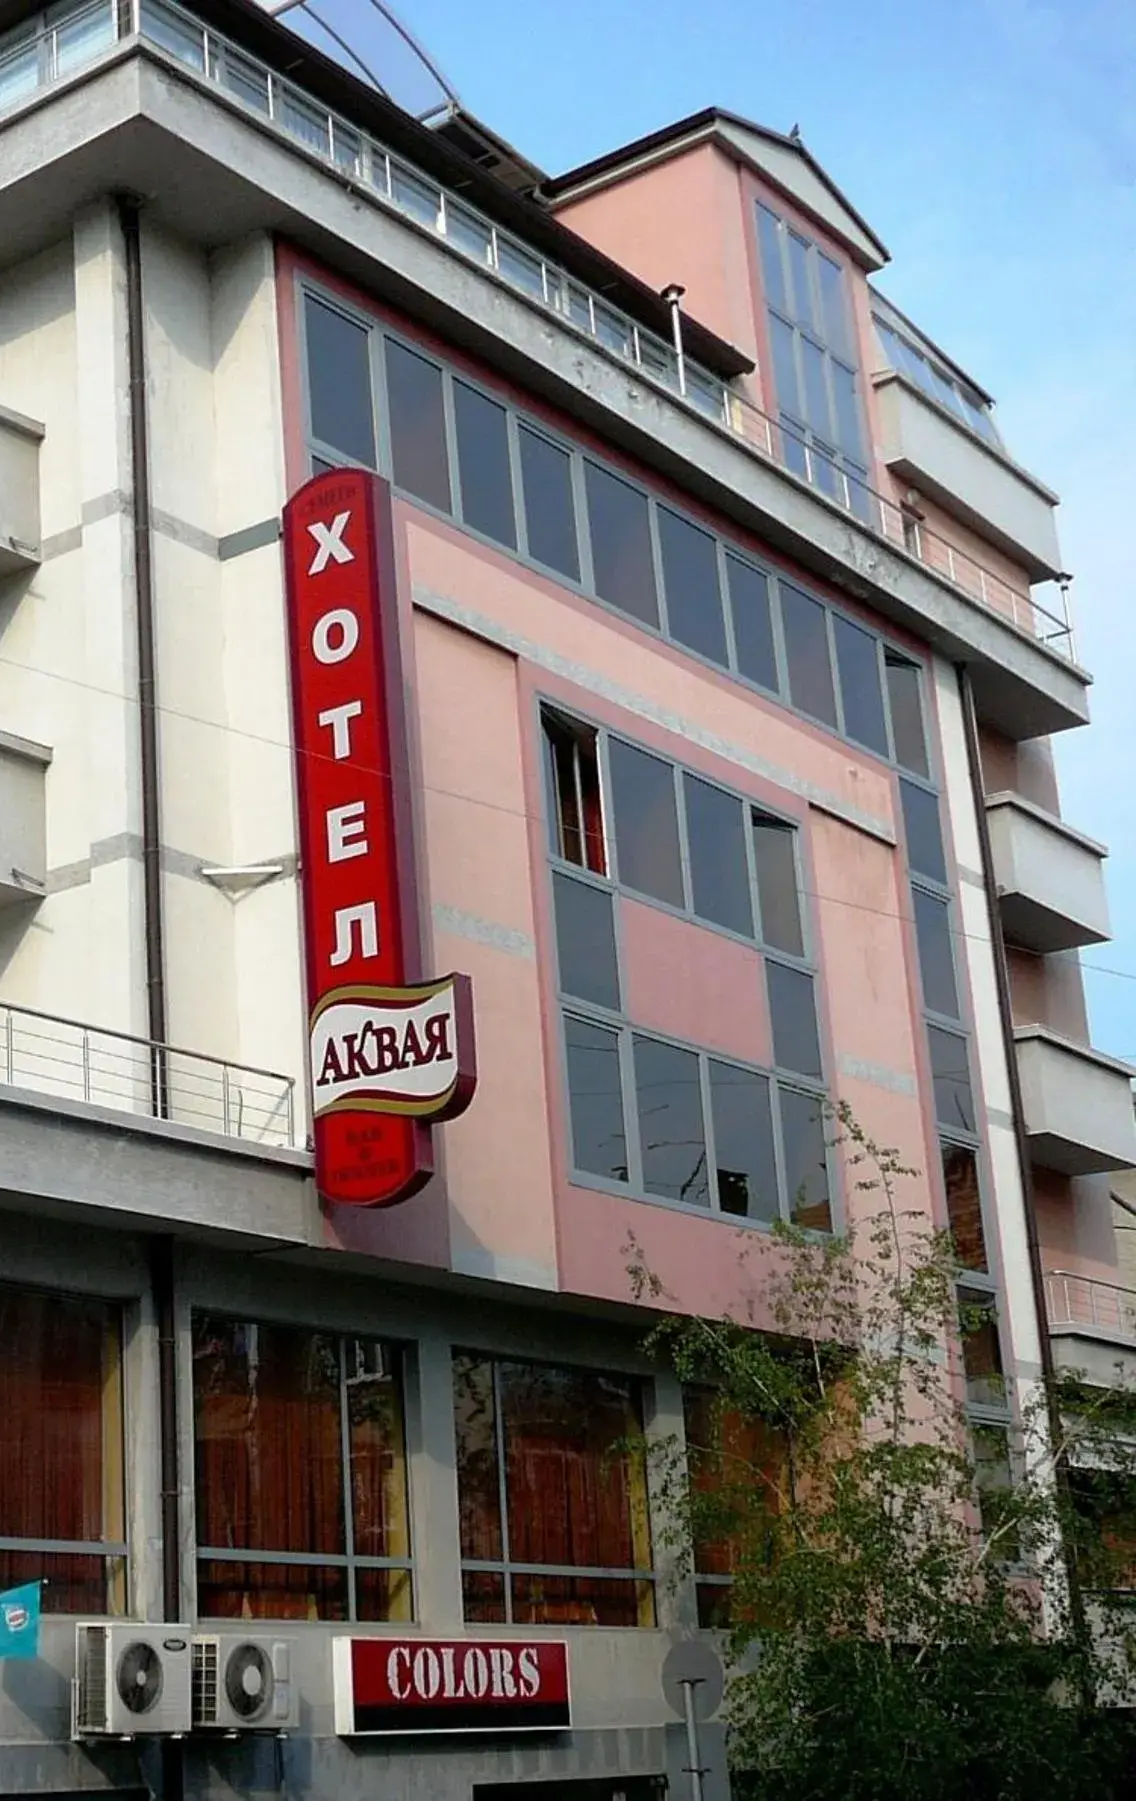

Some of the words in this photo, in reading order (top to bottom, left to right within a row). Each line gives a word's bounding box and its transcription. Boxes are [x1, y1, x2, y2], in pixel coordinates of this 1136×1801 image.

[307, 510, 379, 967] ХОТЕЛ
[316, 1012, 453, 1087] АКВАЯ
[387, 1646, 541, 1699] COLORS
